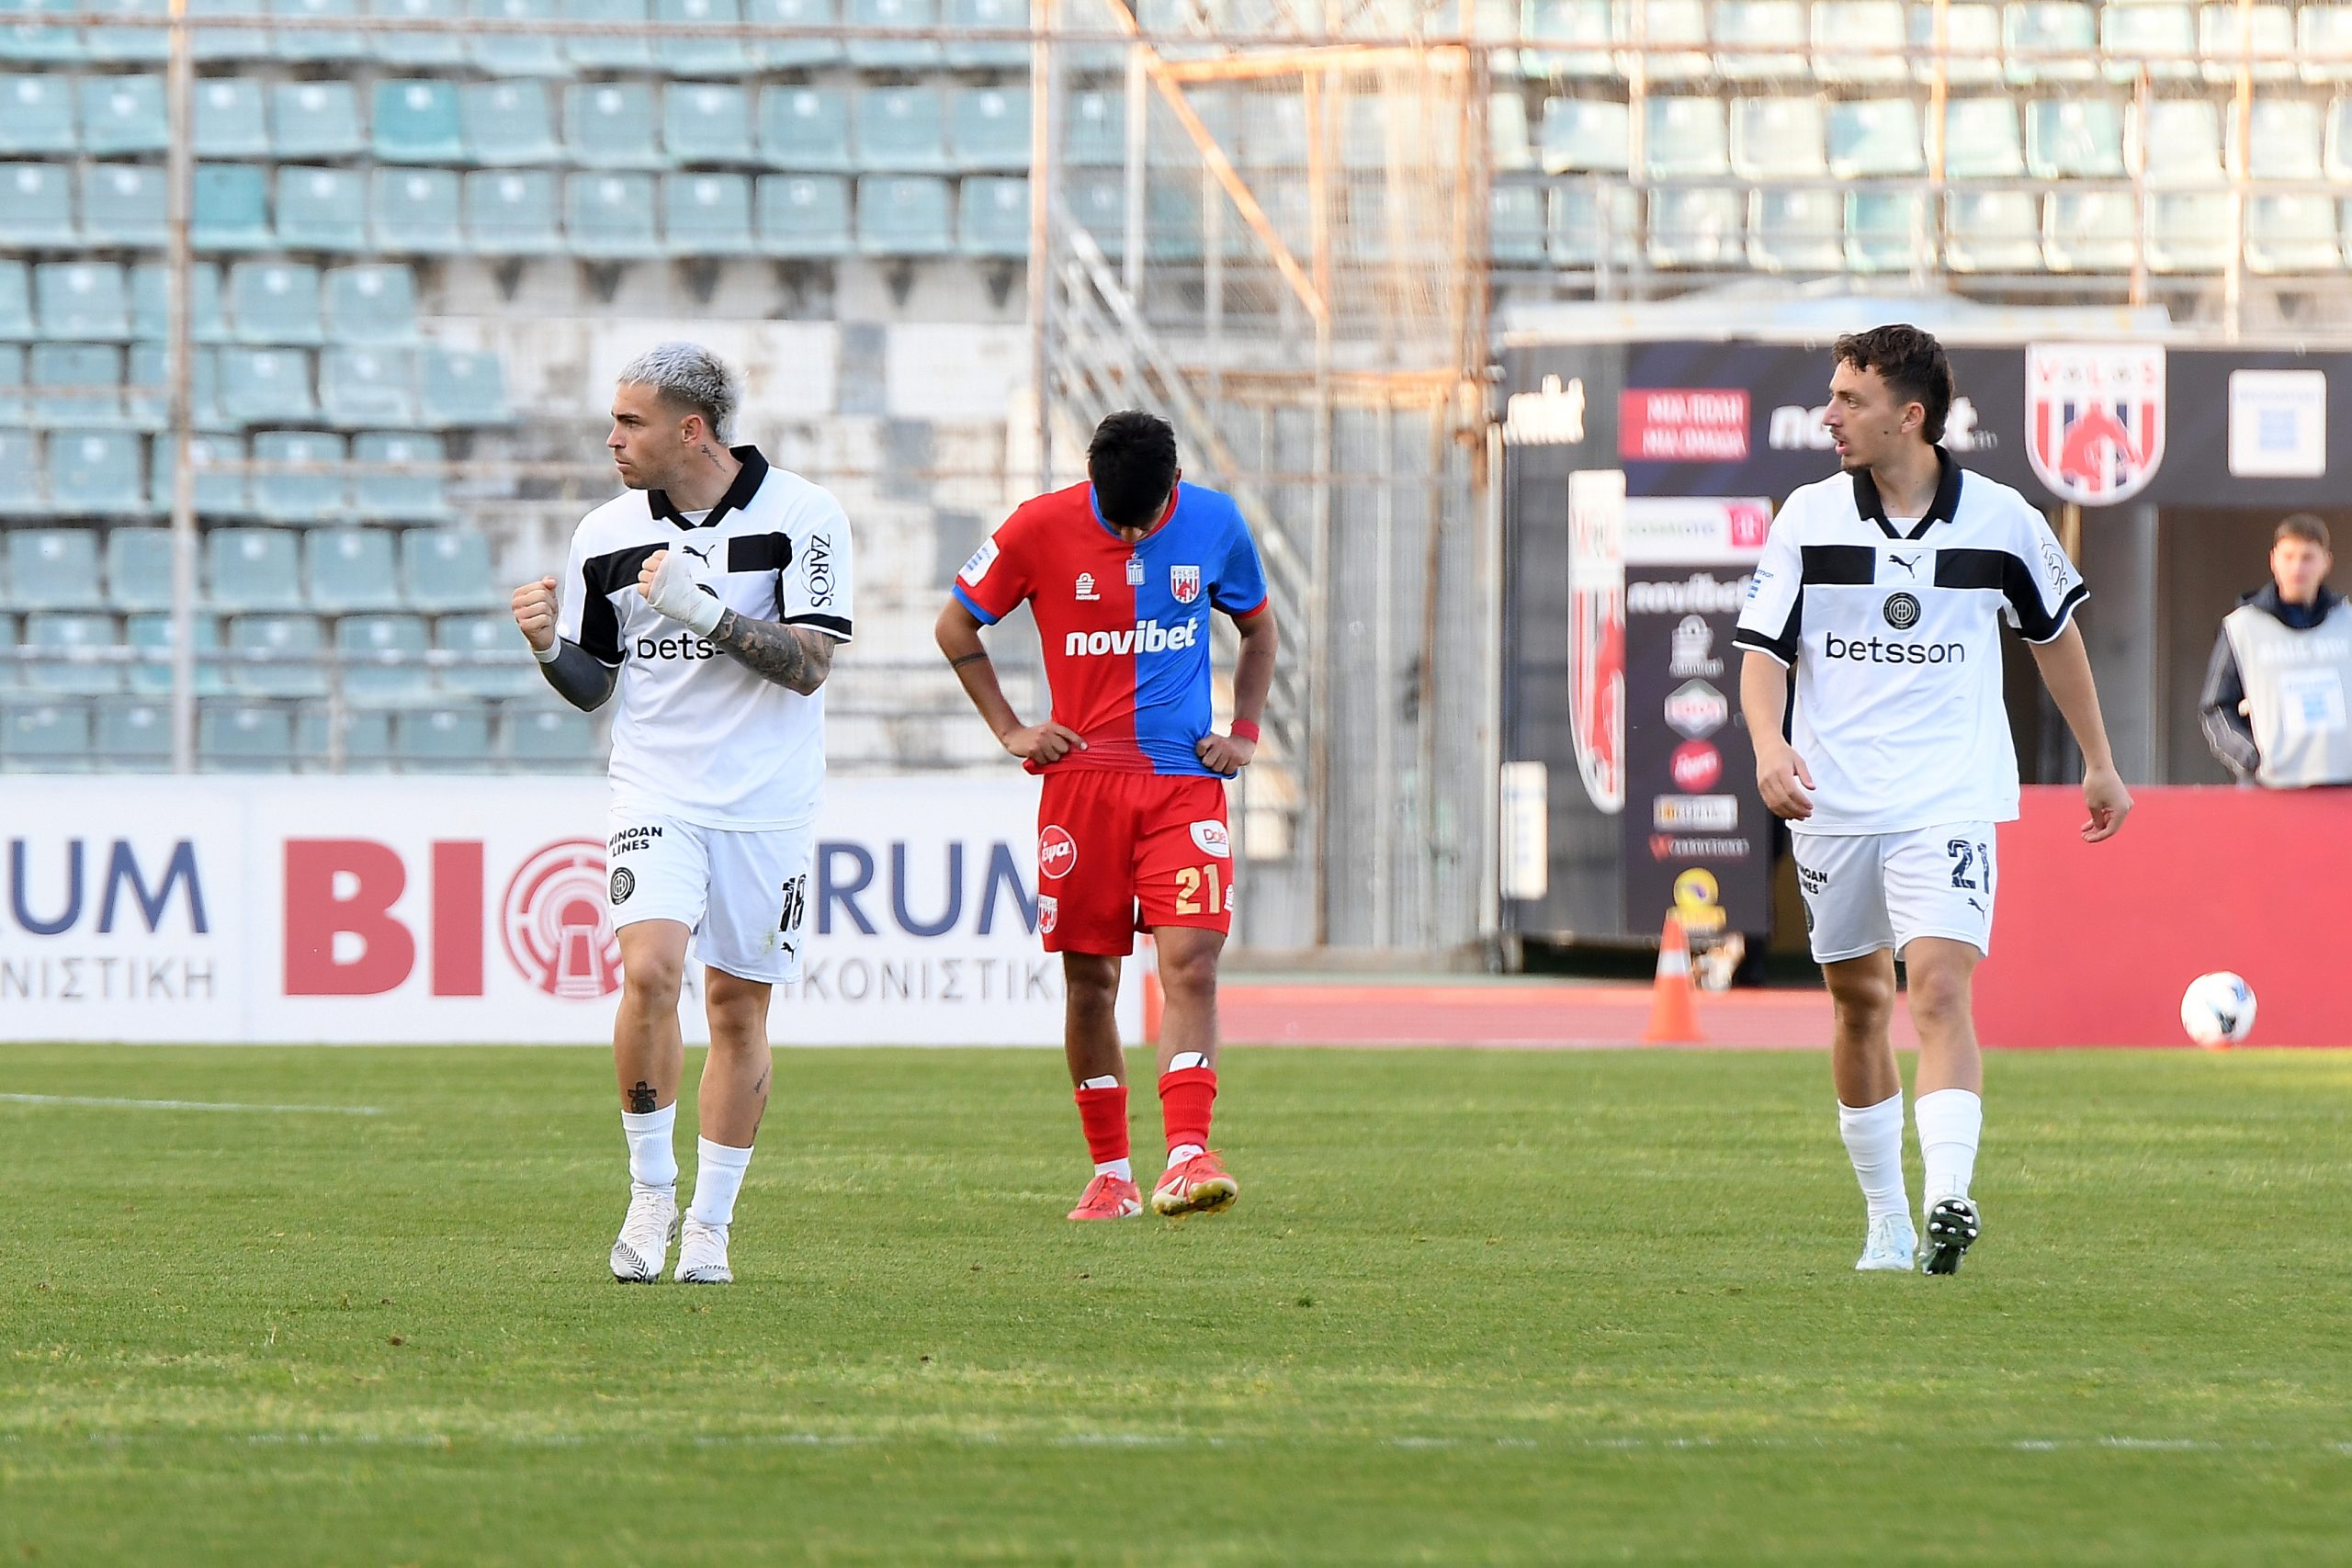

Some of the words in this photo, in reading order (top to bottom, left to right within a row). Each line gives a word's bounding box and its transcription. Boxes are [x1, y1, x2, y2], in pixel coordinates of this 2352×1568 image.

[637, 632, 726, 660] bets
[1065, 616, 1199, 657] novibet
[1826, 631, 1965, 664] betsson
[612, 839, 650, 858] LINES
[1947, 839, 1990, 895] 21
[8, 838, 209, 935] UM
[778, 874, 807, 932] 18
[817, 840, 1040, 937] RUM
[1175, 863, 1221, 915] 21
